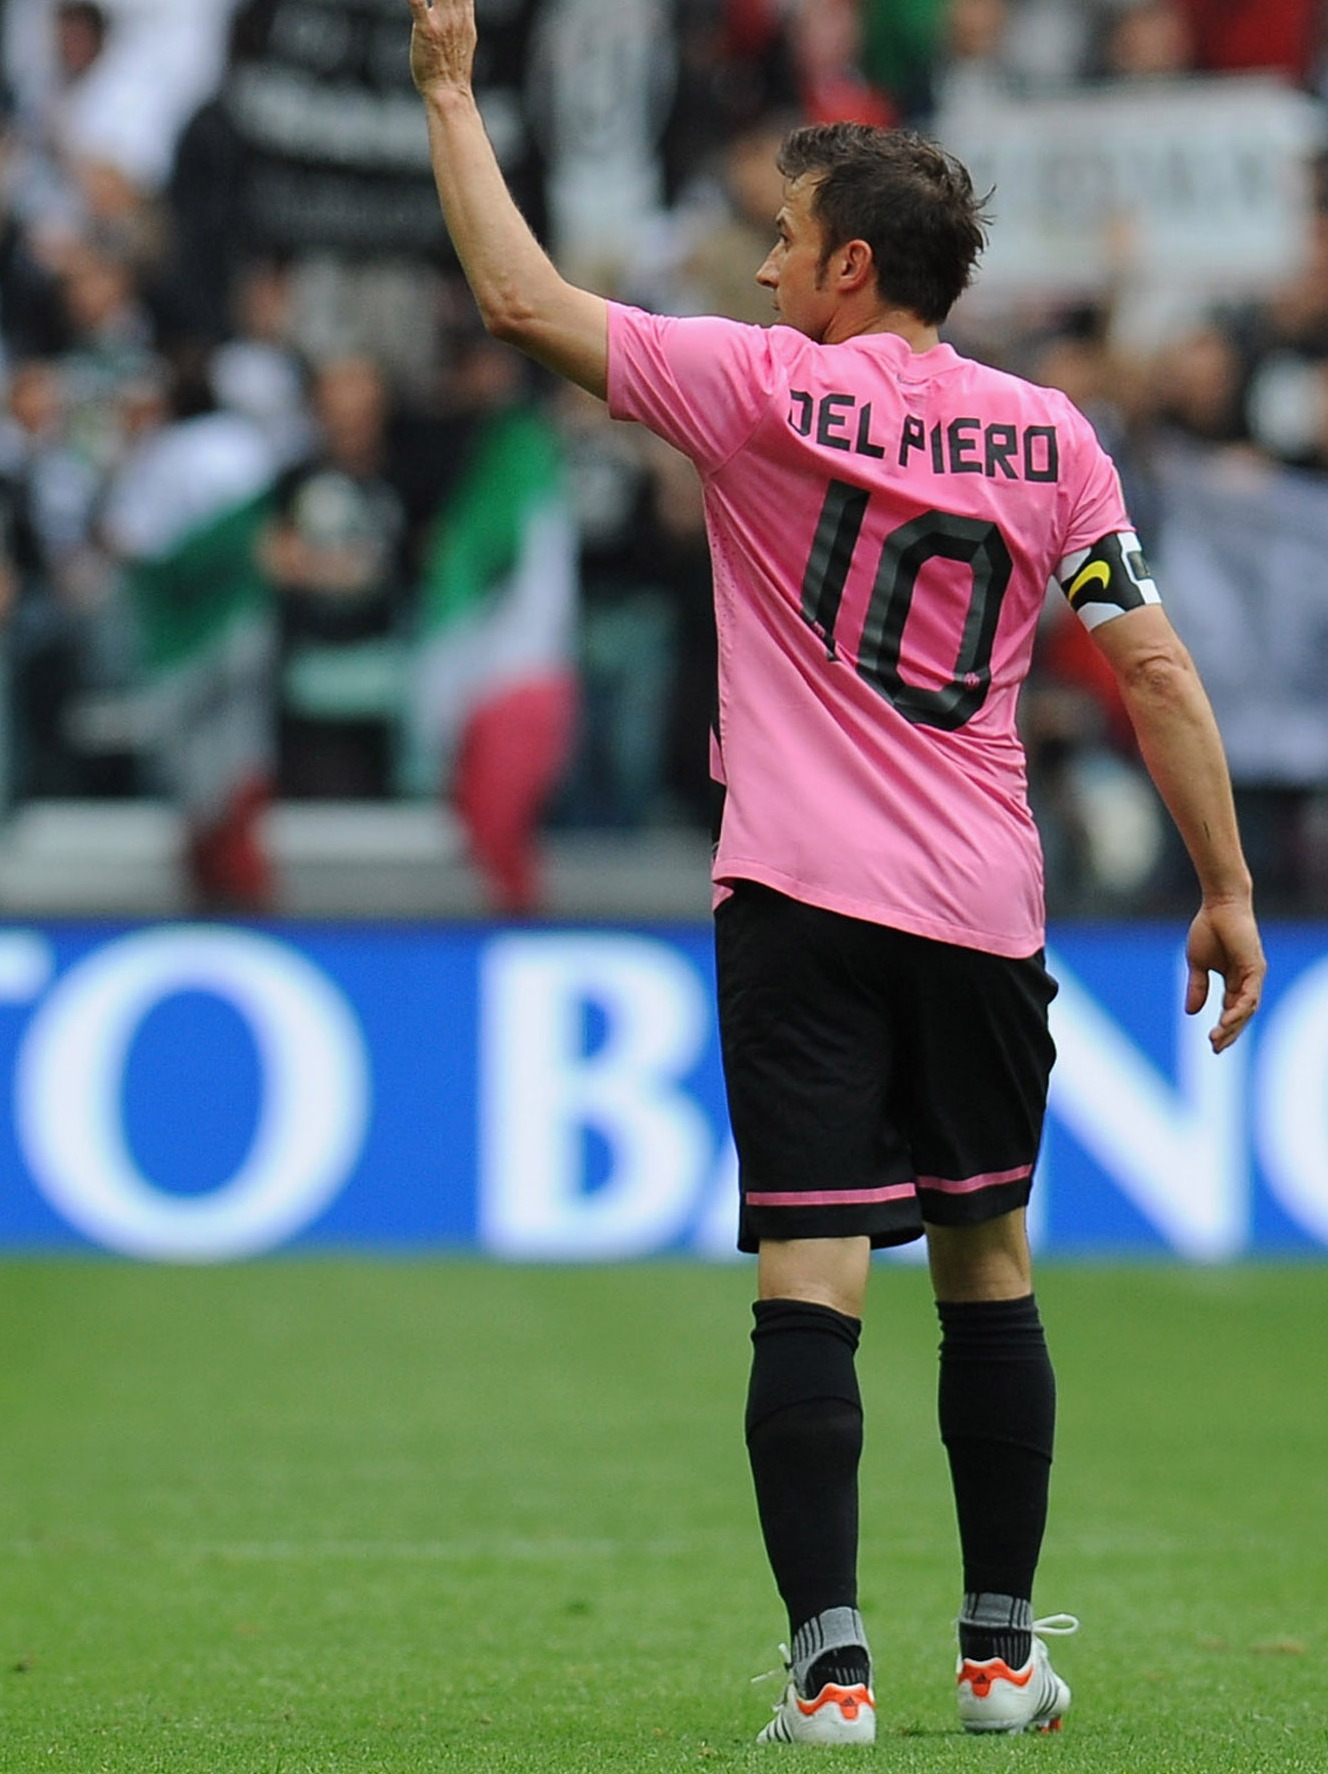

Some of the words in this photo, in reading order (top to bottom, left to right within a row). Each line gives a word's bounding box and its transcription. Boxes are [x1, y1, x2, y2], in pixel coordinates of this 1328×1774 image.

[787, 388, 886, 460] DEL
[898, 414, 1059, 484] PIERO
[800, 478, 1014, 731] 10
[478, 928, 1328, 1264] BN
